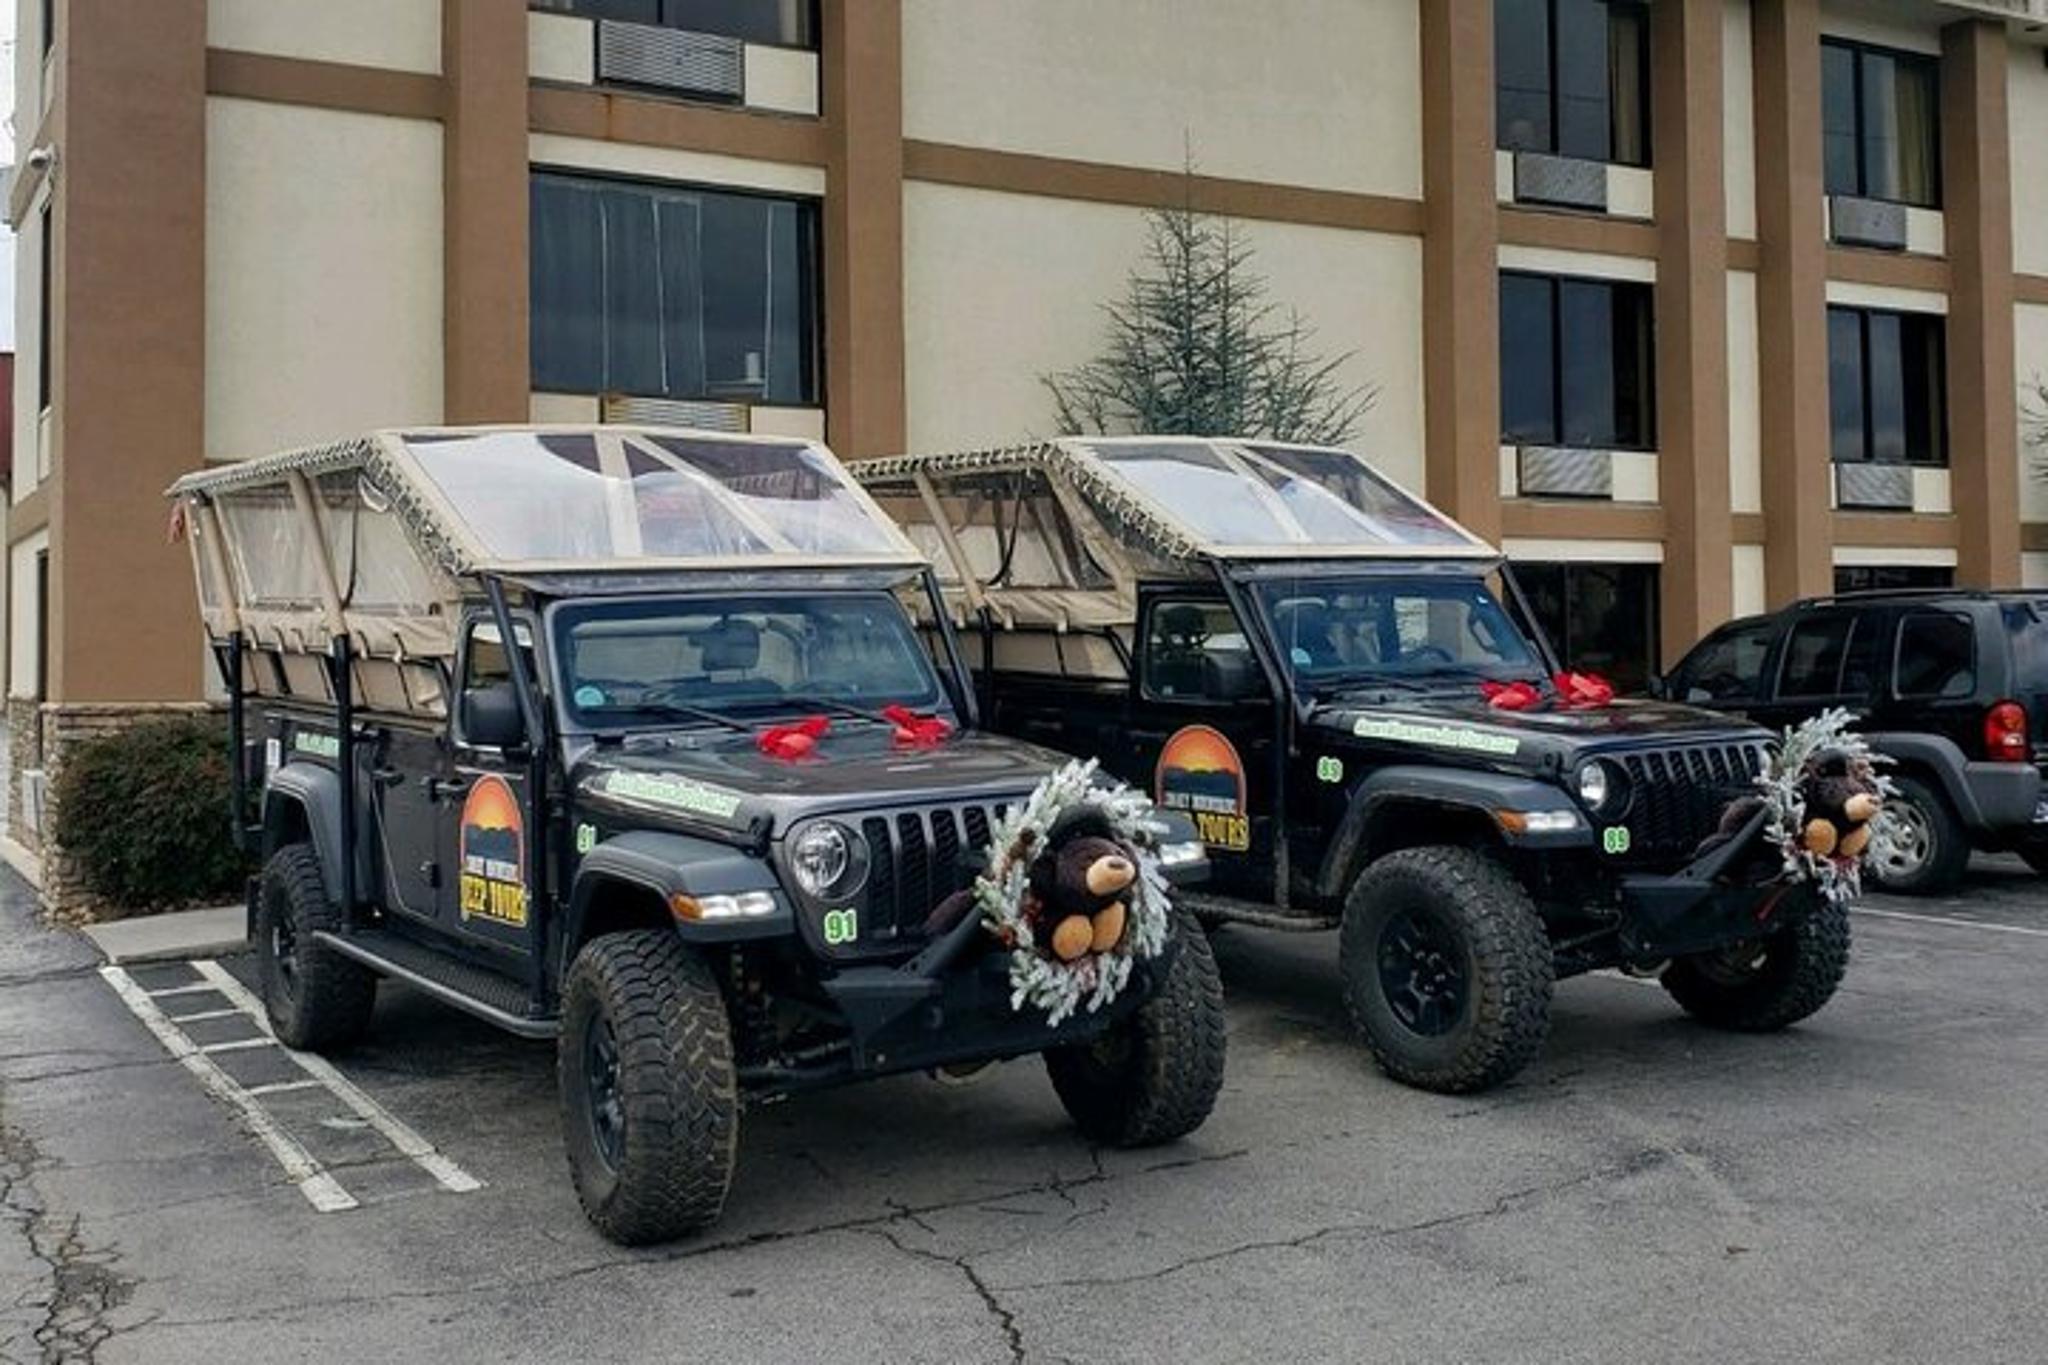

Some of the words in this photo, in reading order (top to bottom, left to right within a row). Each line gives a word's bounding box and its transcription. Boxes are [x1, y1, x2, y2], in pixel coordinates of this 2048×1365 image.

[1197, 812, 1249, 850] TOURS
[1604, 826, 1630, 853] 89
[825, 909, 857, 944] 91
